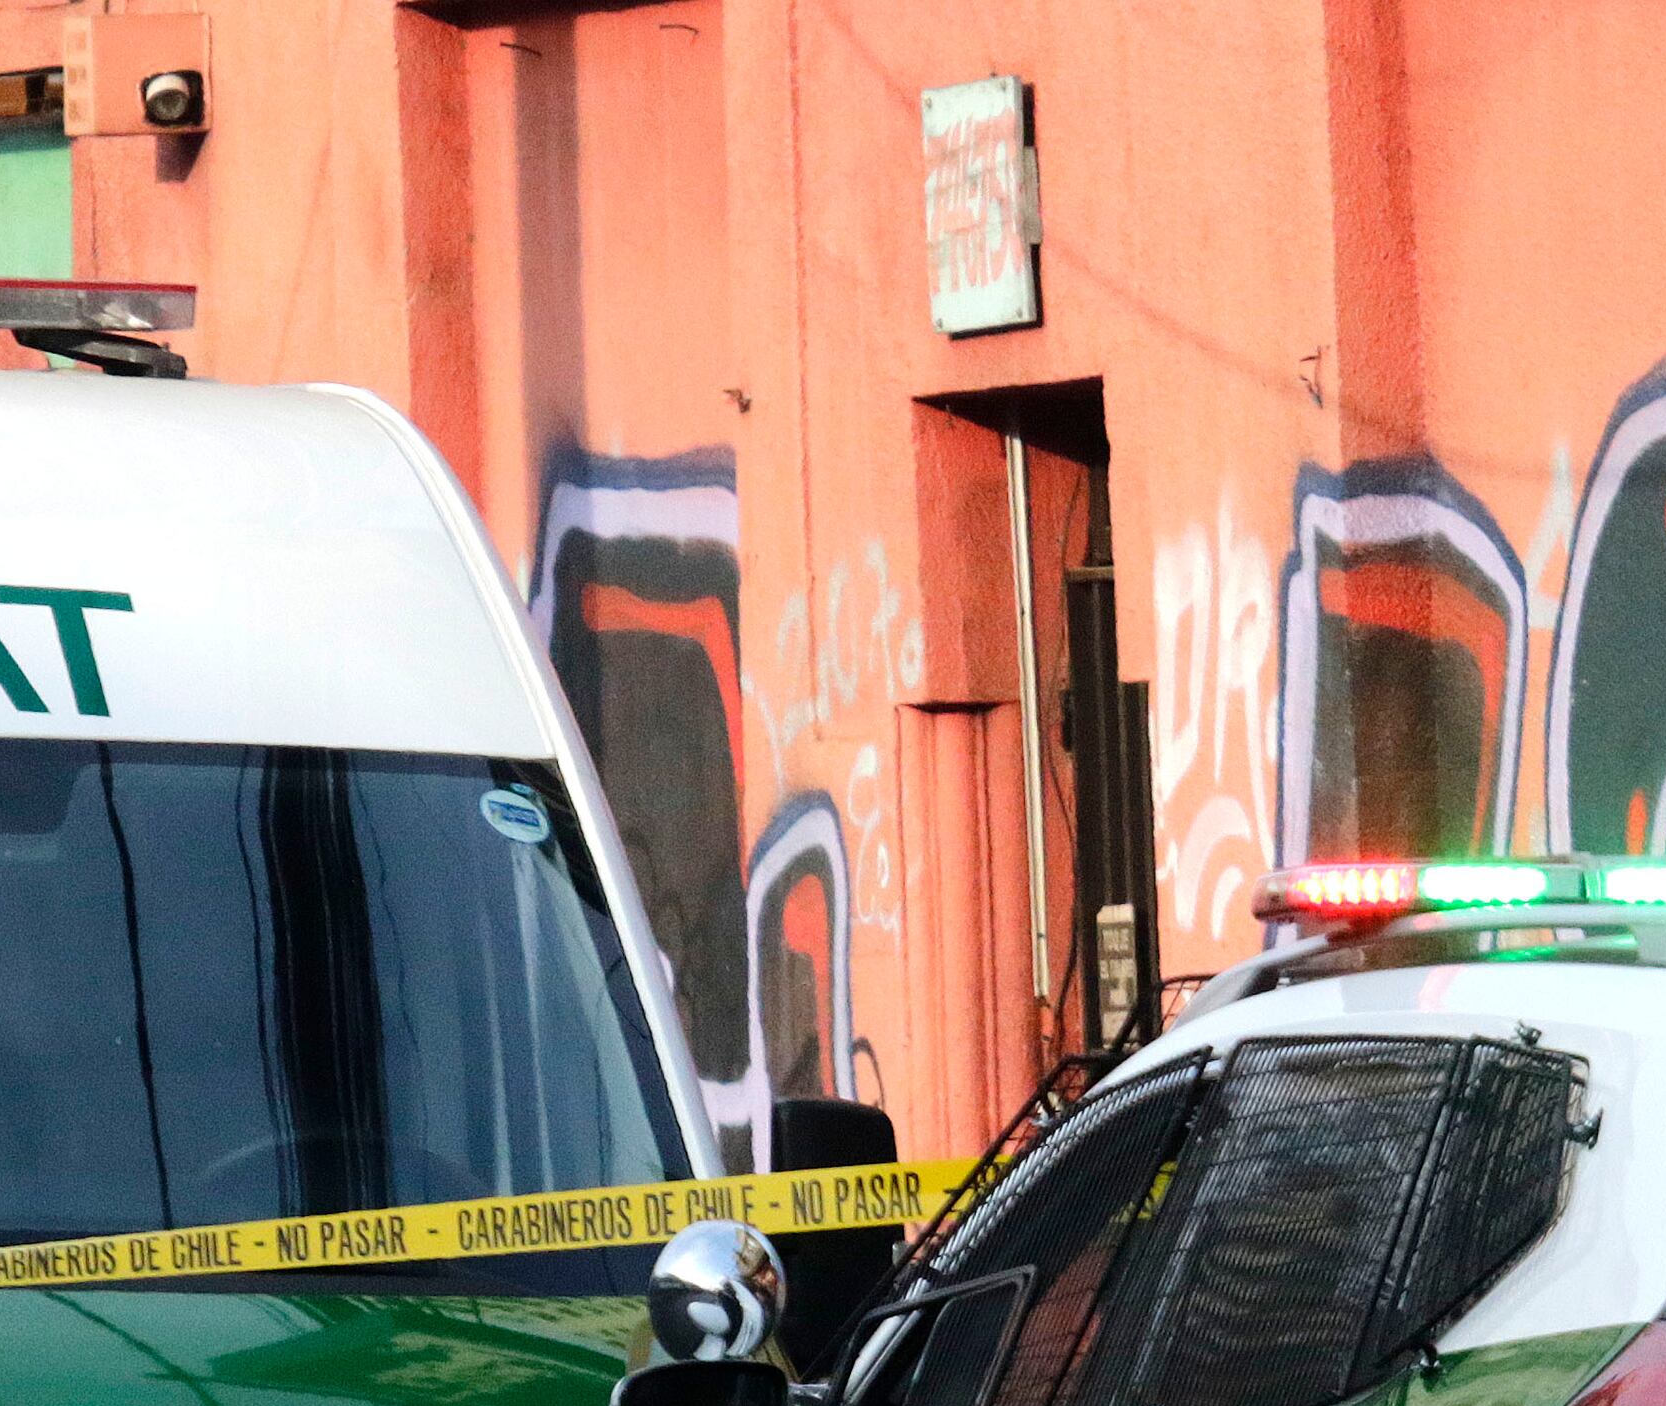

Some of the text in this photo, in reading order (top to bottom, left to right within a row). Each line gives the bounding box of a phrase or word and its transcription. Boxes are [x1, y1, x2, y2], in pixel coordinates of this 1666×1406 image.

[129, 1236, 161, 1272] DE
[171, 1229, 242, 1269] CHILE
[276, 1224, 308, 1264] NO
[321, 1215, 407, 1258] PASAR
[457, 1199, 631, 1250] CARABINEROS
[645, 1191, 677, 1235] DE
[791, 1180, 824, 1225] NO
[836, 1172, 923, 1221] PASAR
